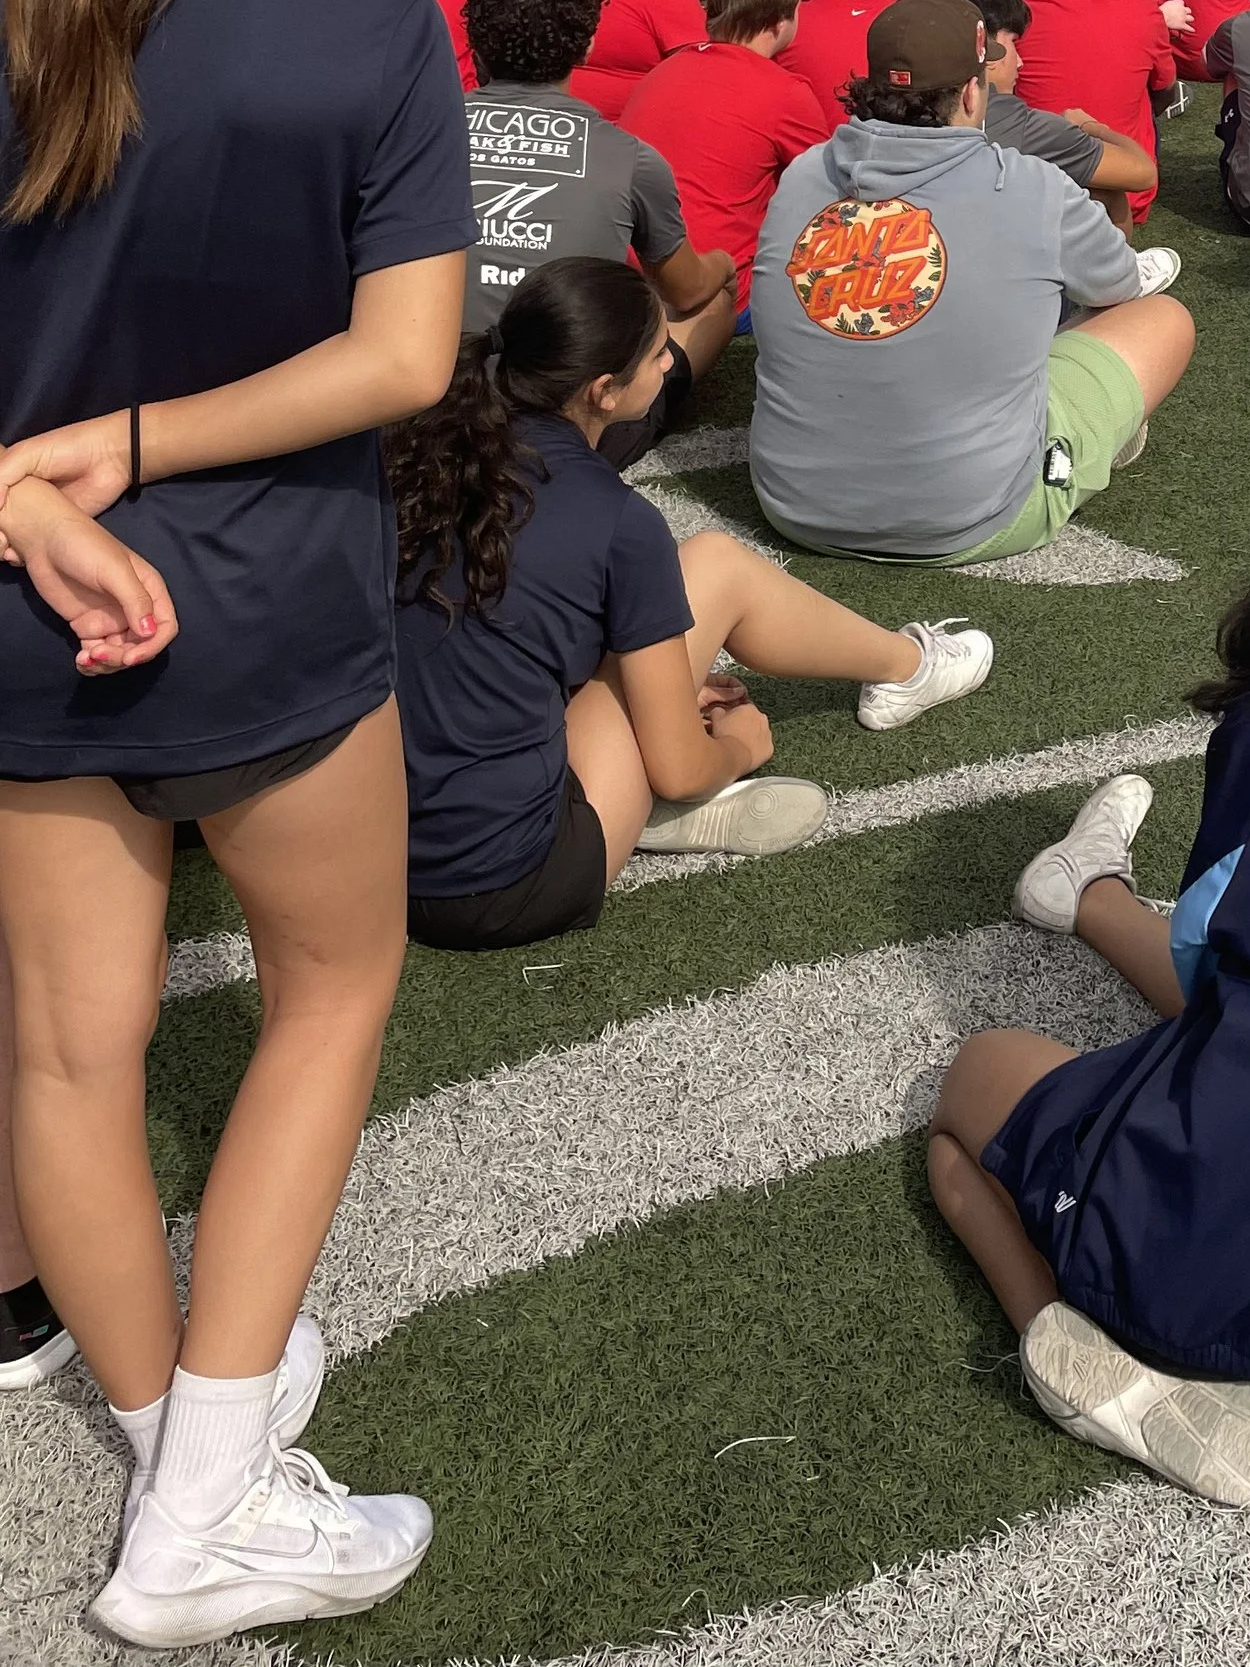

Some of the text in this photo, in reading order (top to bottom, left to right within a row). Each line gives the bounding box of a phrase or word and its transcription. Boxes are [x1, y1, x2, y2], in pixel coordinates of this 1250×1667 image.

[465, 109, 576, 139] HICAGO
[518, 140, 569, 155] FISH
[490, 155, 536, 166] GATOS
[475, 236, 549, 250] UNDATION
[476, 218, 553, 243] IUCCI
[786, 209, 932, 276] SANTA
[809, 256, 927, 320] CRUZ
